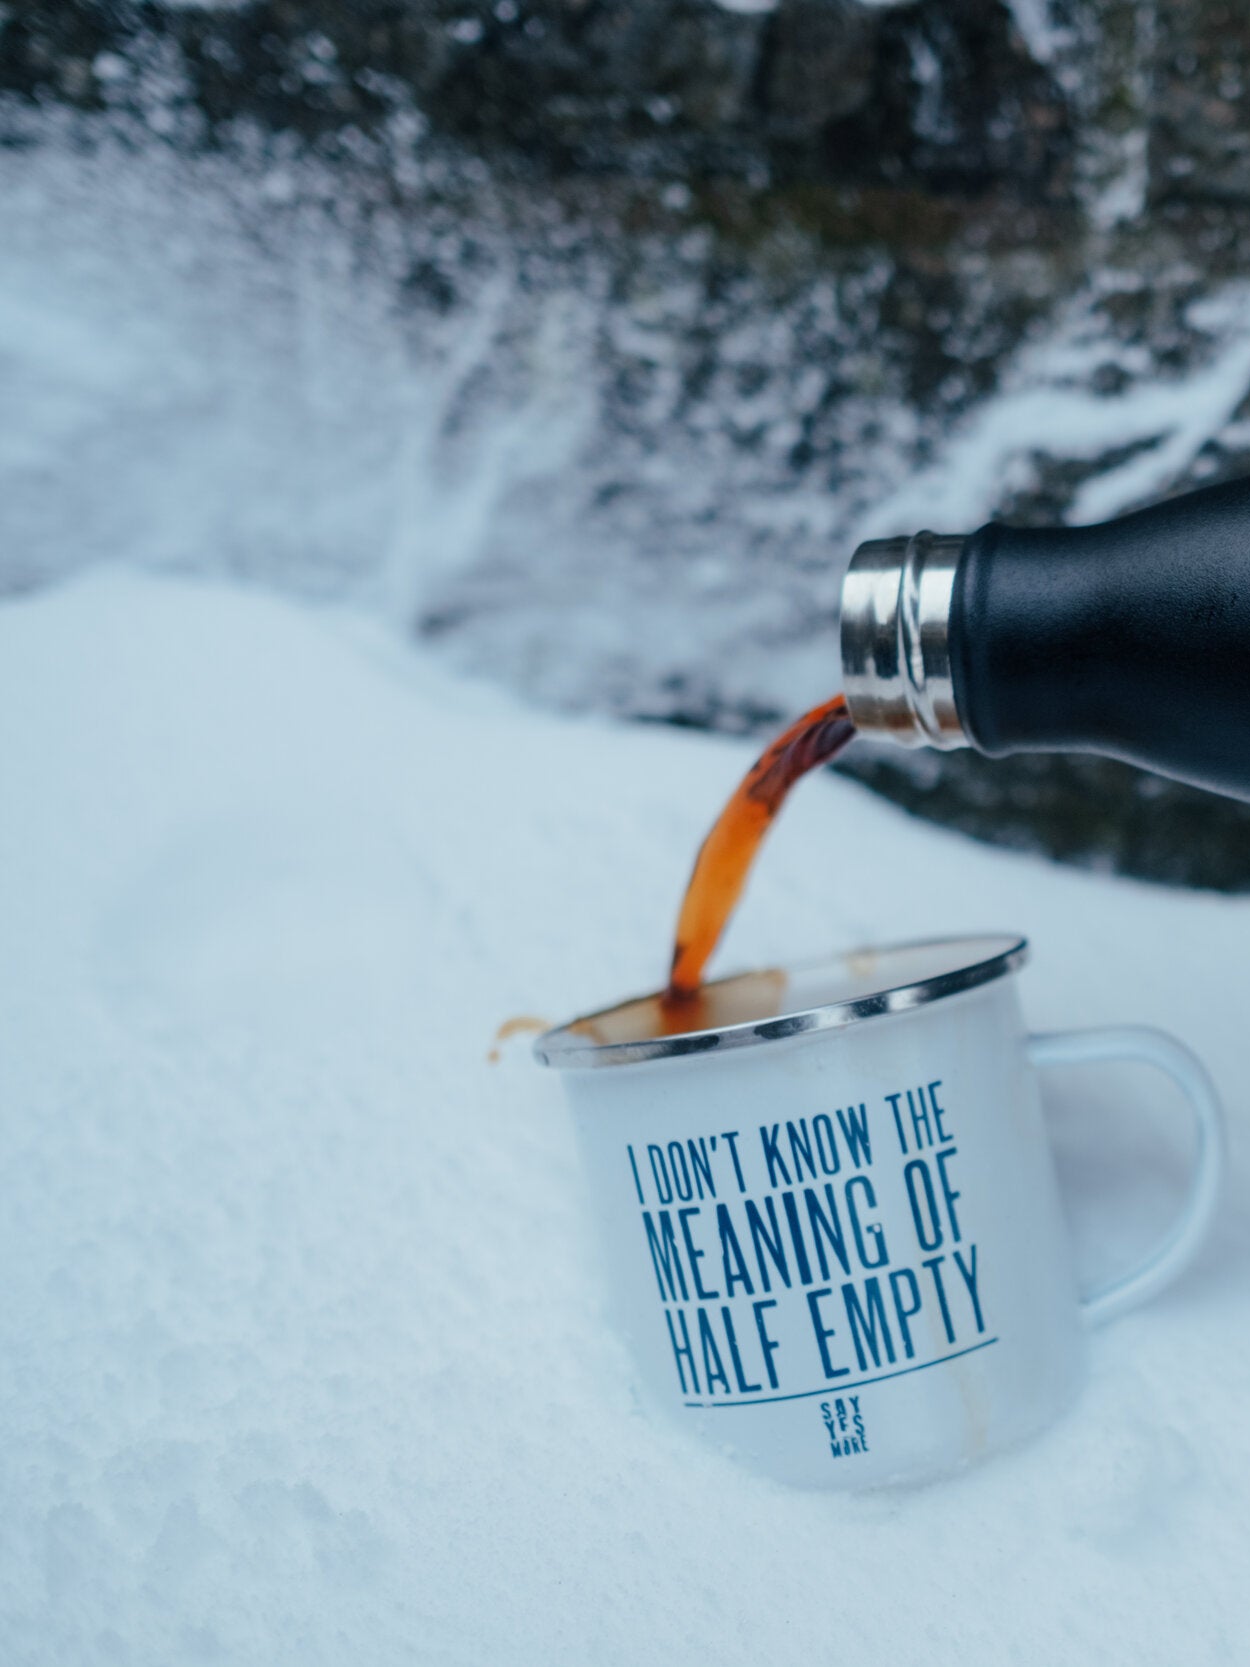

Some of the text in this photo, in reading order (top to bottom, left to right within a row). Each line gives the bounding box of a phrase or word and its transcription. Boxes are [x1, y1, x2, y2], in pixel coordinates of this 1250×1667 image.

[628, 1081, 954, 1205] I DON'T KNOW THE
[642, 1147, 960, 1302] MEANING OF
[665, 1244, 985, 1395] HALF EMPTY
[820, 1396, 860, 1420] SAY
[824, 1415, 865, 1440] YES
[830, 1435, 869, 1458] MORE
